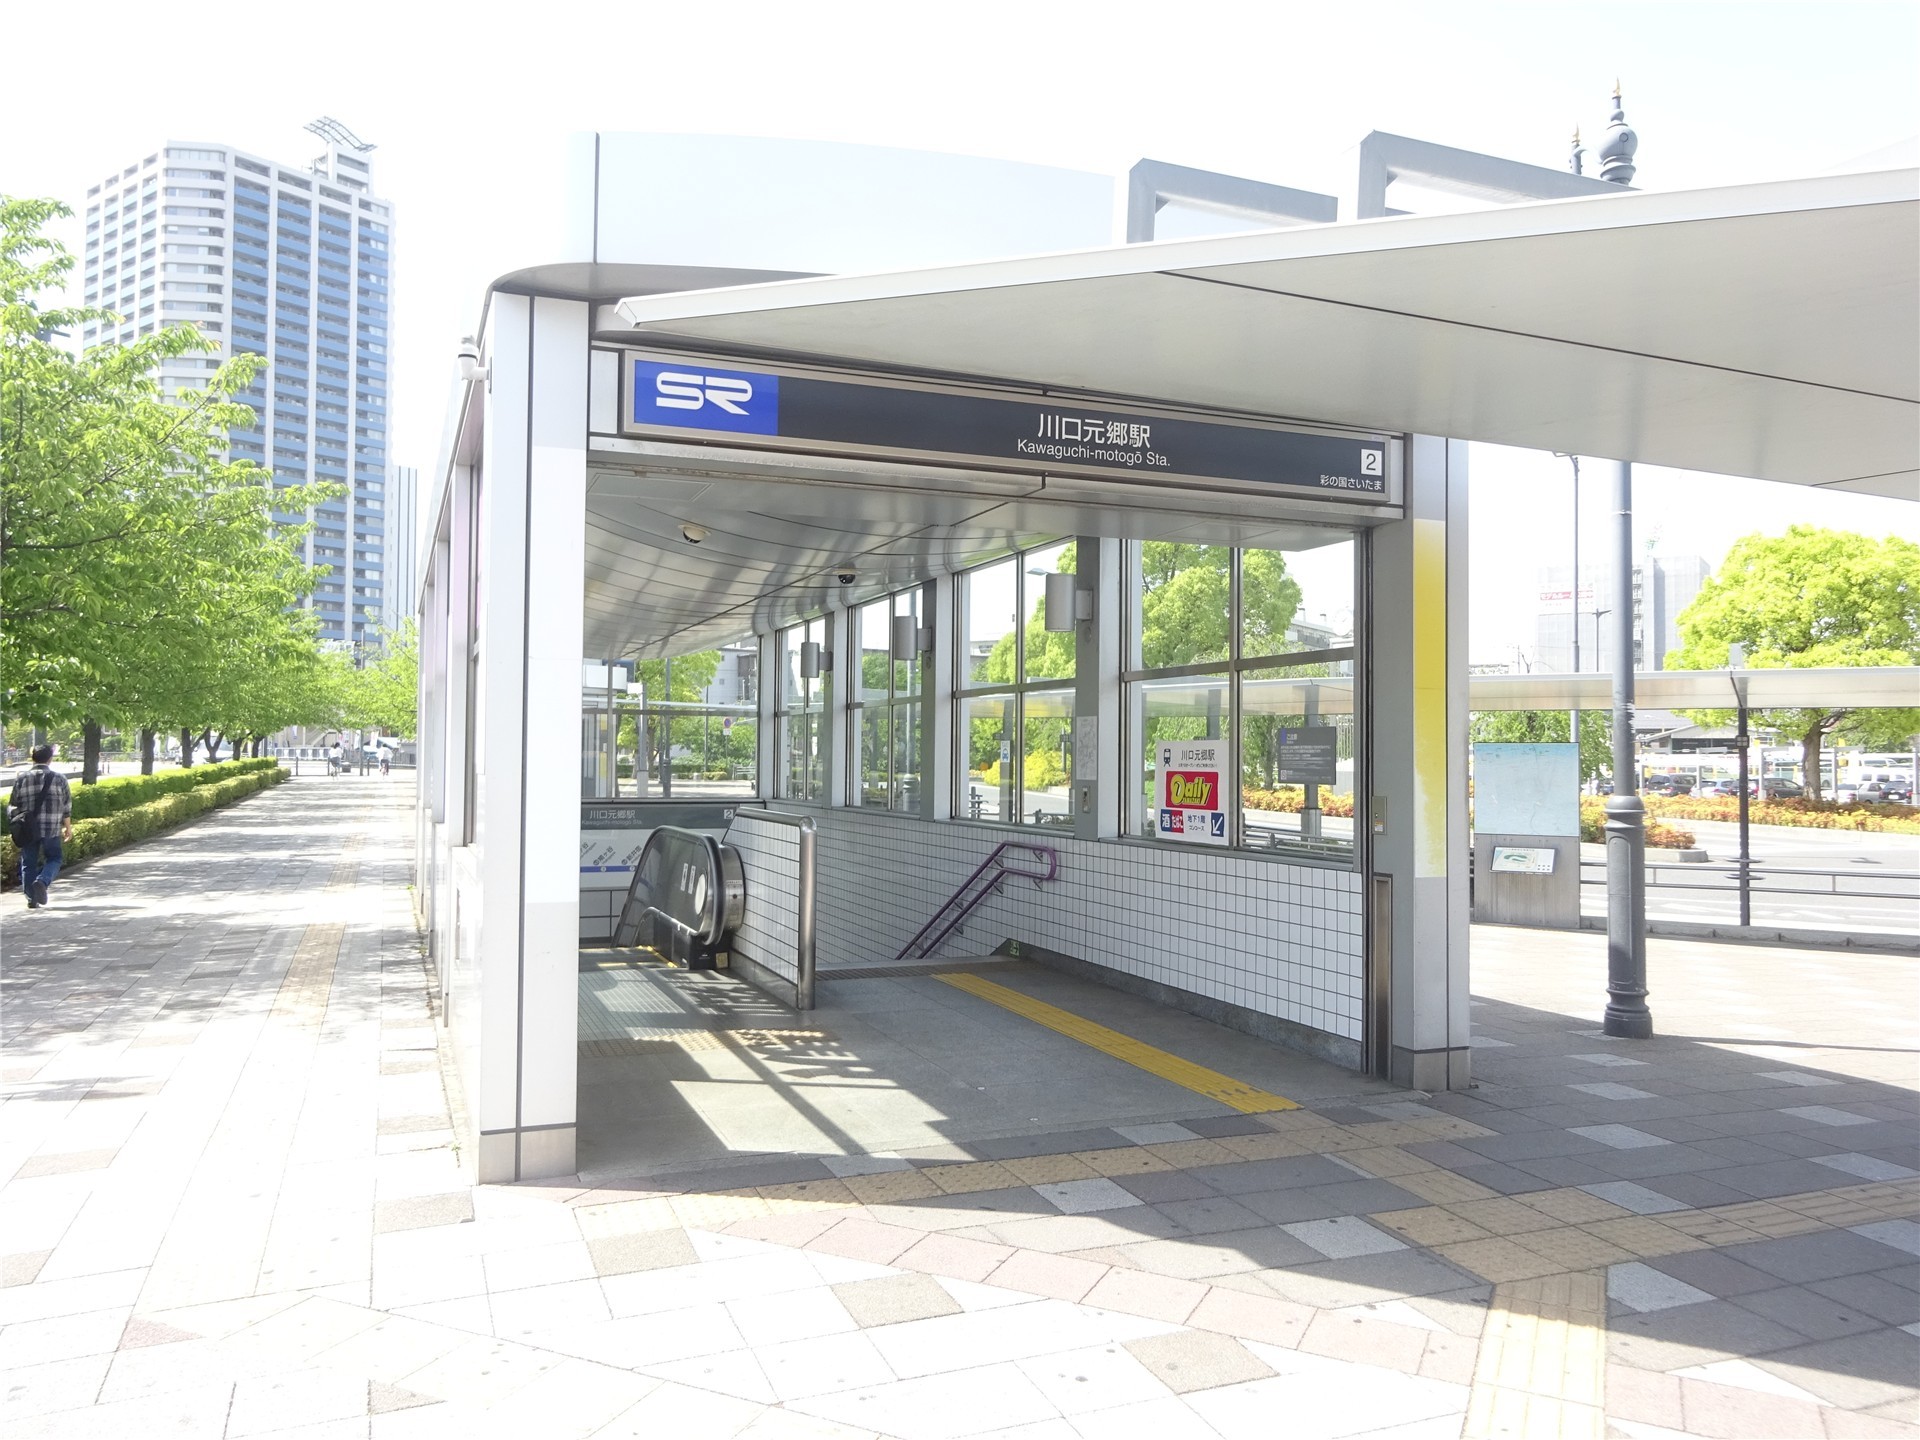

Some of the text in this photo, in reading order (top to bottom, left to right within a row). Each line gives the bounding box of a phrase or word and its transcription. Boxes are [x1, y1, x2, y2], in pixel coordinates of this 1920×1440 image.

[656, 371, 753, 416] SR
[1037, 413, 1151, 449] 川口元郷駅
[1017, 438, 1171, 467] Kawaguchi-motogō Sta.
[1365, 453, 1376, 471] 2
[1319, 474, 1382, 491] 彩の国さいたま
[1181, 748, 1216, 761] 川口元郷駅
[1170, 773, 1213, 806] Daily
[589, 809, 636, 819] 川口元郷駅
[1162, 813, 1171, 828] 酒
[1187, 814, 1206, 824] 地下1階
